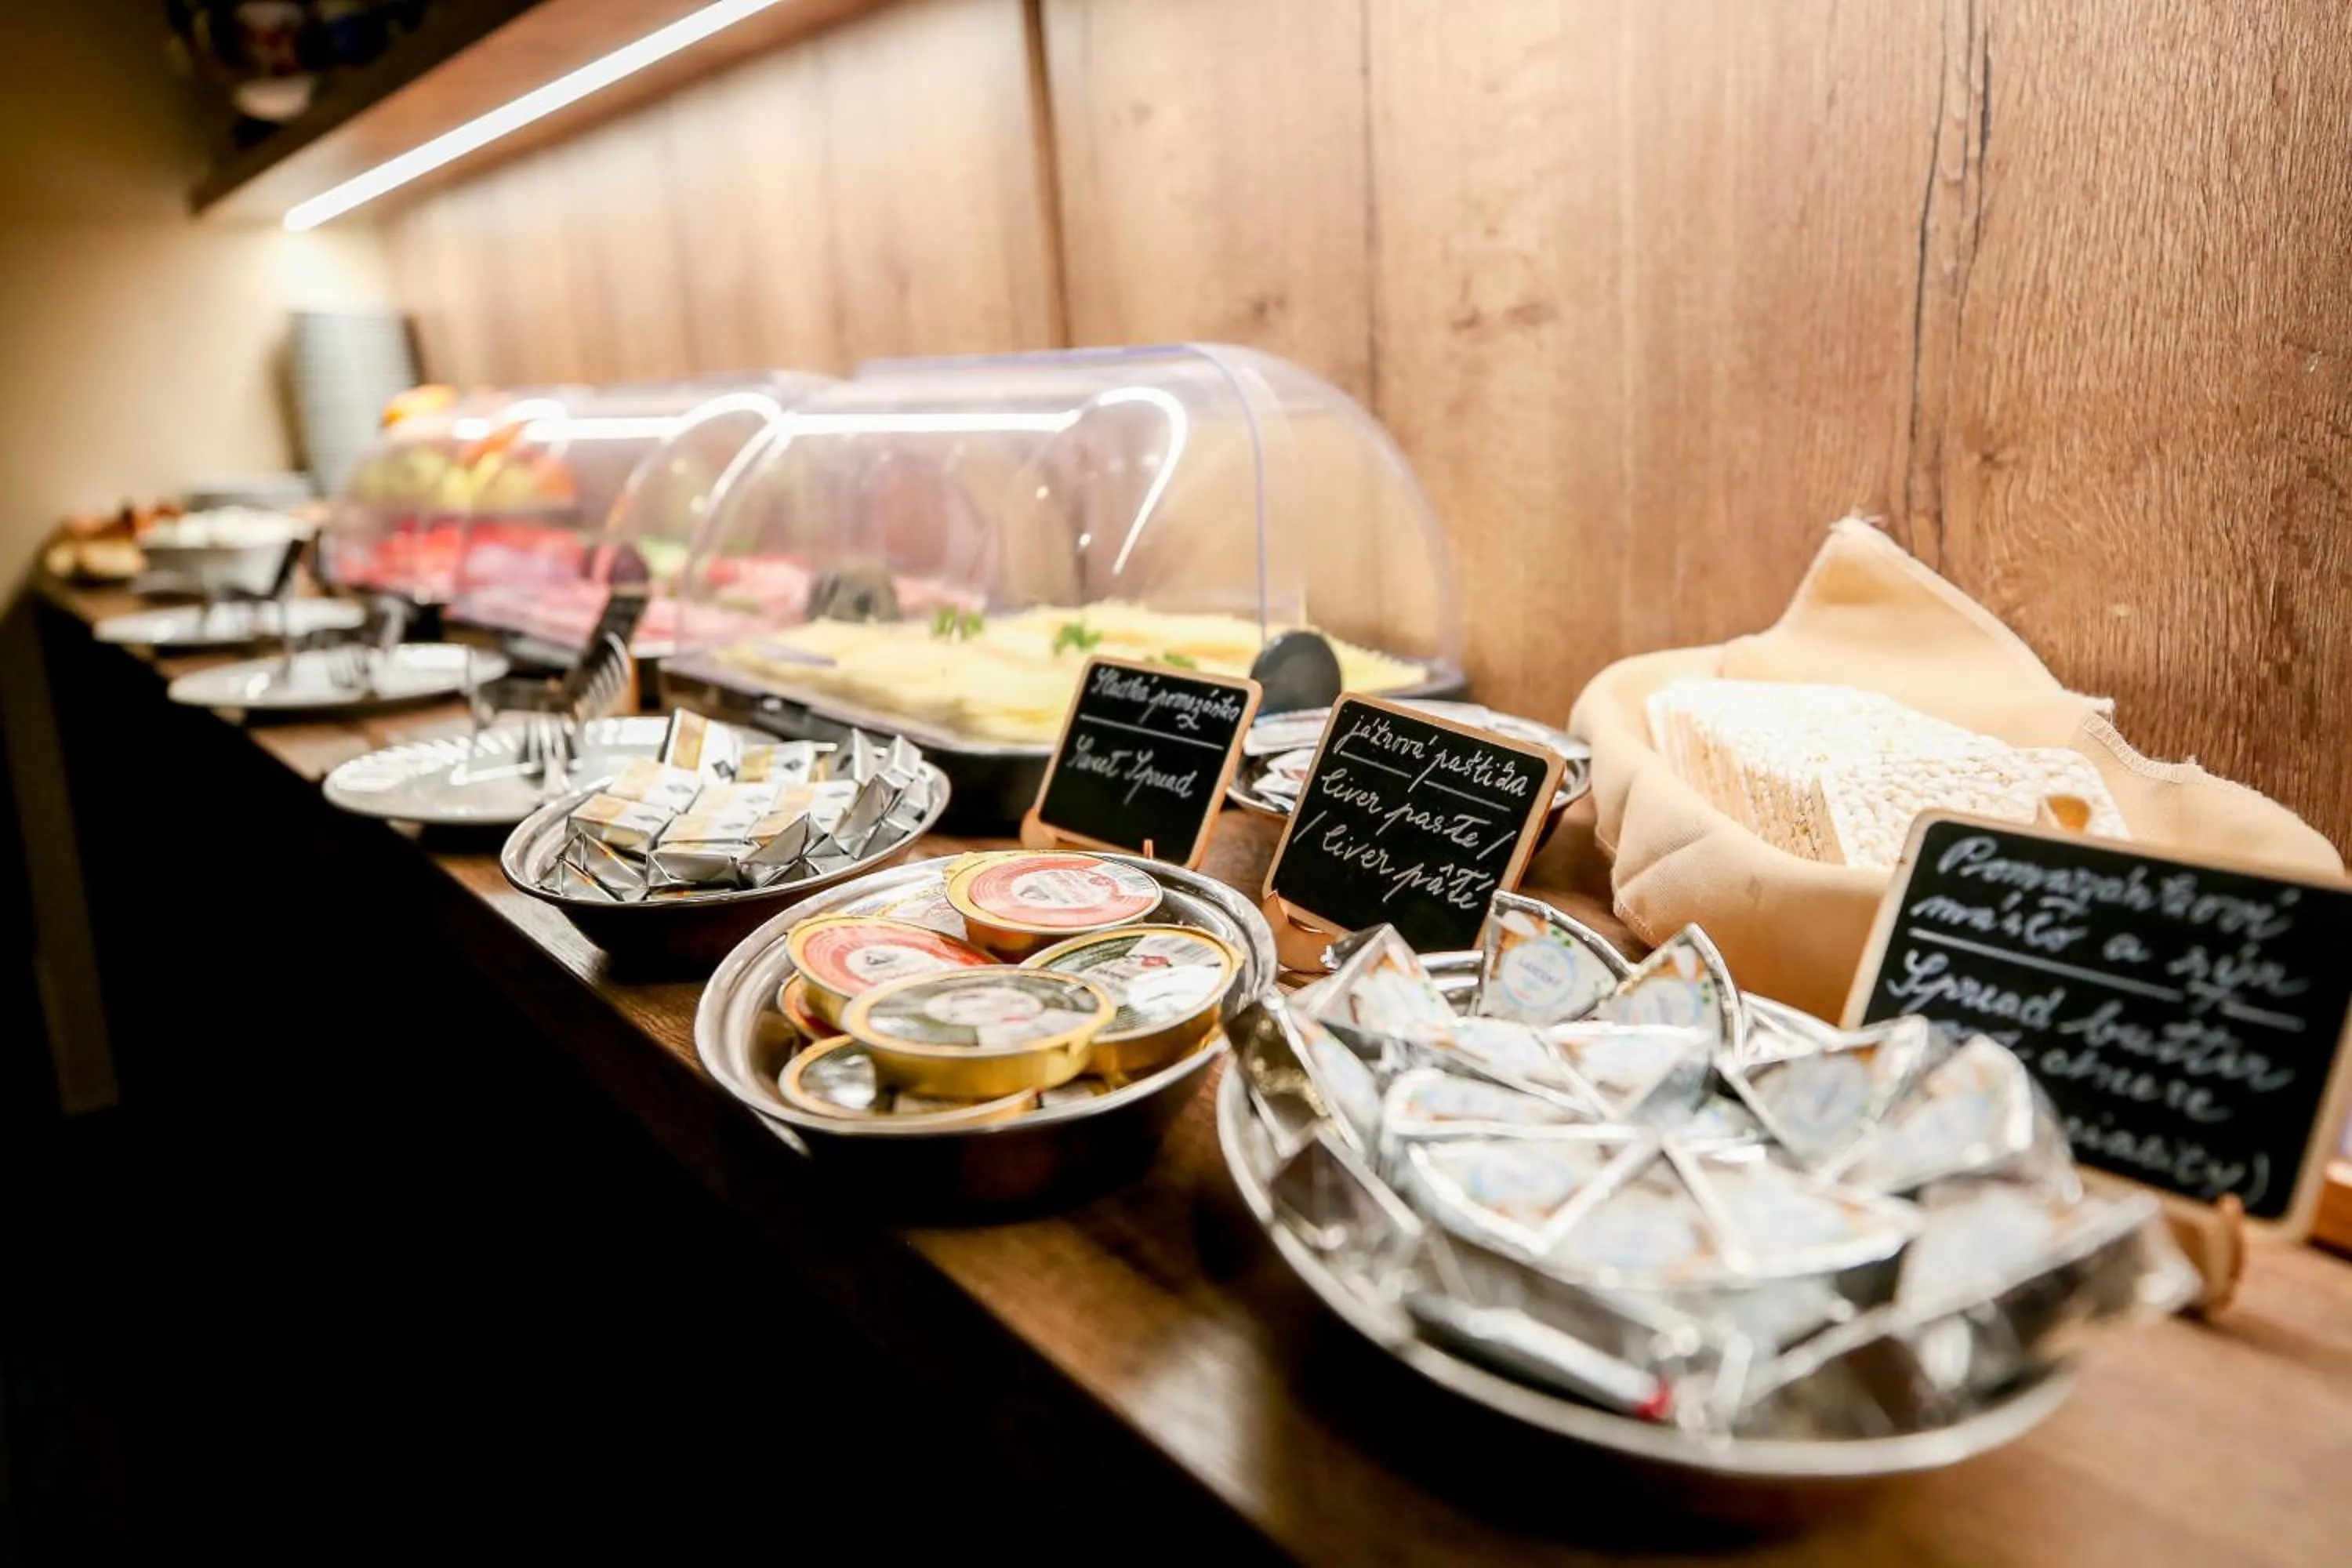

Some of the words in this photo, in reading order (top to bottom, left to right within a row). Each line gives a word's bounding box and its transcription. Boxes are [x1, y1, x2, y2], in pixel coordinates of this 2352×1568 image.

[1065, 734, 1132, 778] Sweet
[1123, 749, 1199, 807] Spread
[1334, 715, 1437, 760] játrová
[1321, 768, 1383, 815] liver
[1375, 802, 1493, 848] paste
[1322, 823, 1396, 874] liver
[1886, 949, 2067, 1027] Spread
